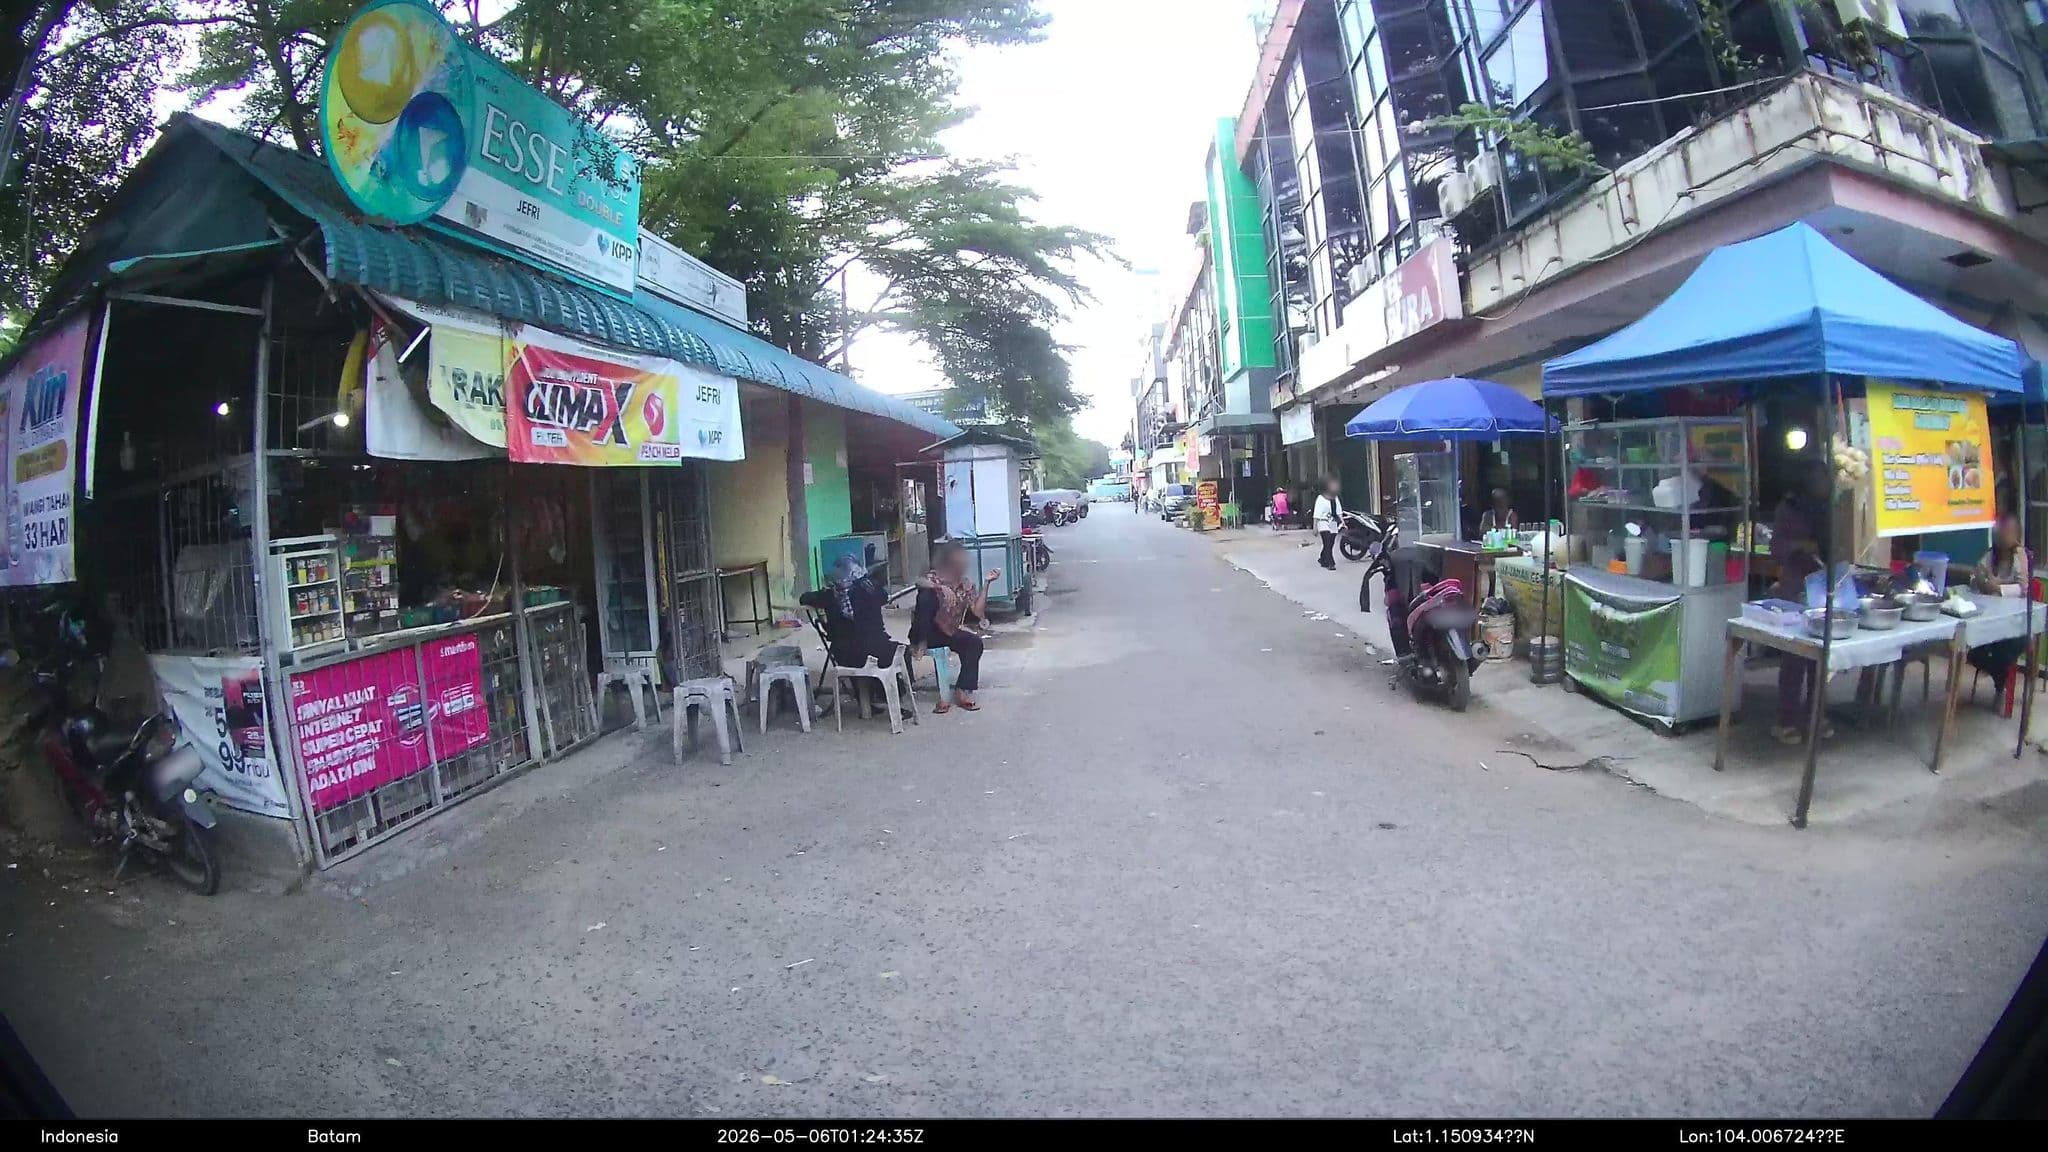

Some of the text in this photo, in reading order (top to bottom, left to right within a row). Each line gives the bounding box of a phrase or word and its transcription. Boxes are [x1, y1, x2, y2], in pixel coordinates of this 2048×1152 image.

[480, 103, 568, 197] ESSE
[516, 199, 541, 221] JEFRI
[611, 240, 633, 262] KPP
[695, 384, 721, 406] JEFRI
[24, 516, 69, 551] 33 HARI
[300, 707, 363, 739] INTERNET
[302, 719, 383, 757] SUPER CEPAT
[310, 770, 339, 793] ADA
